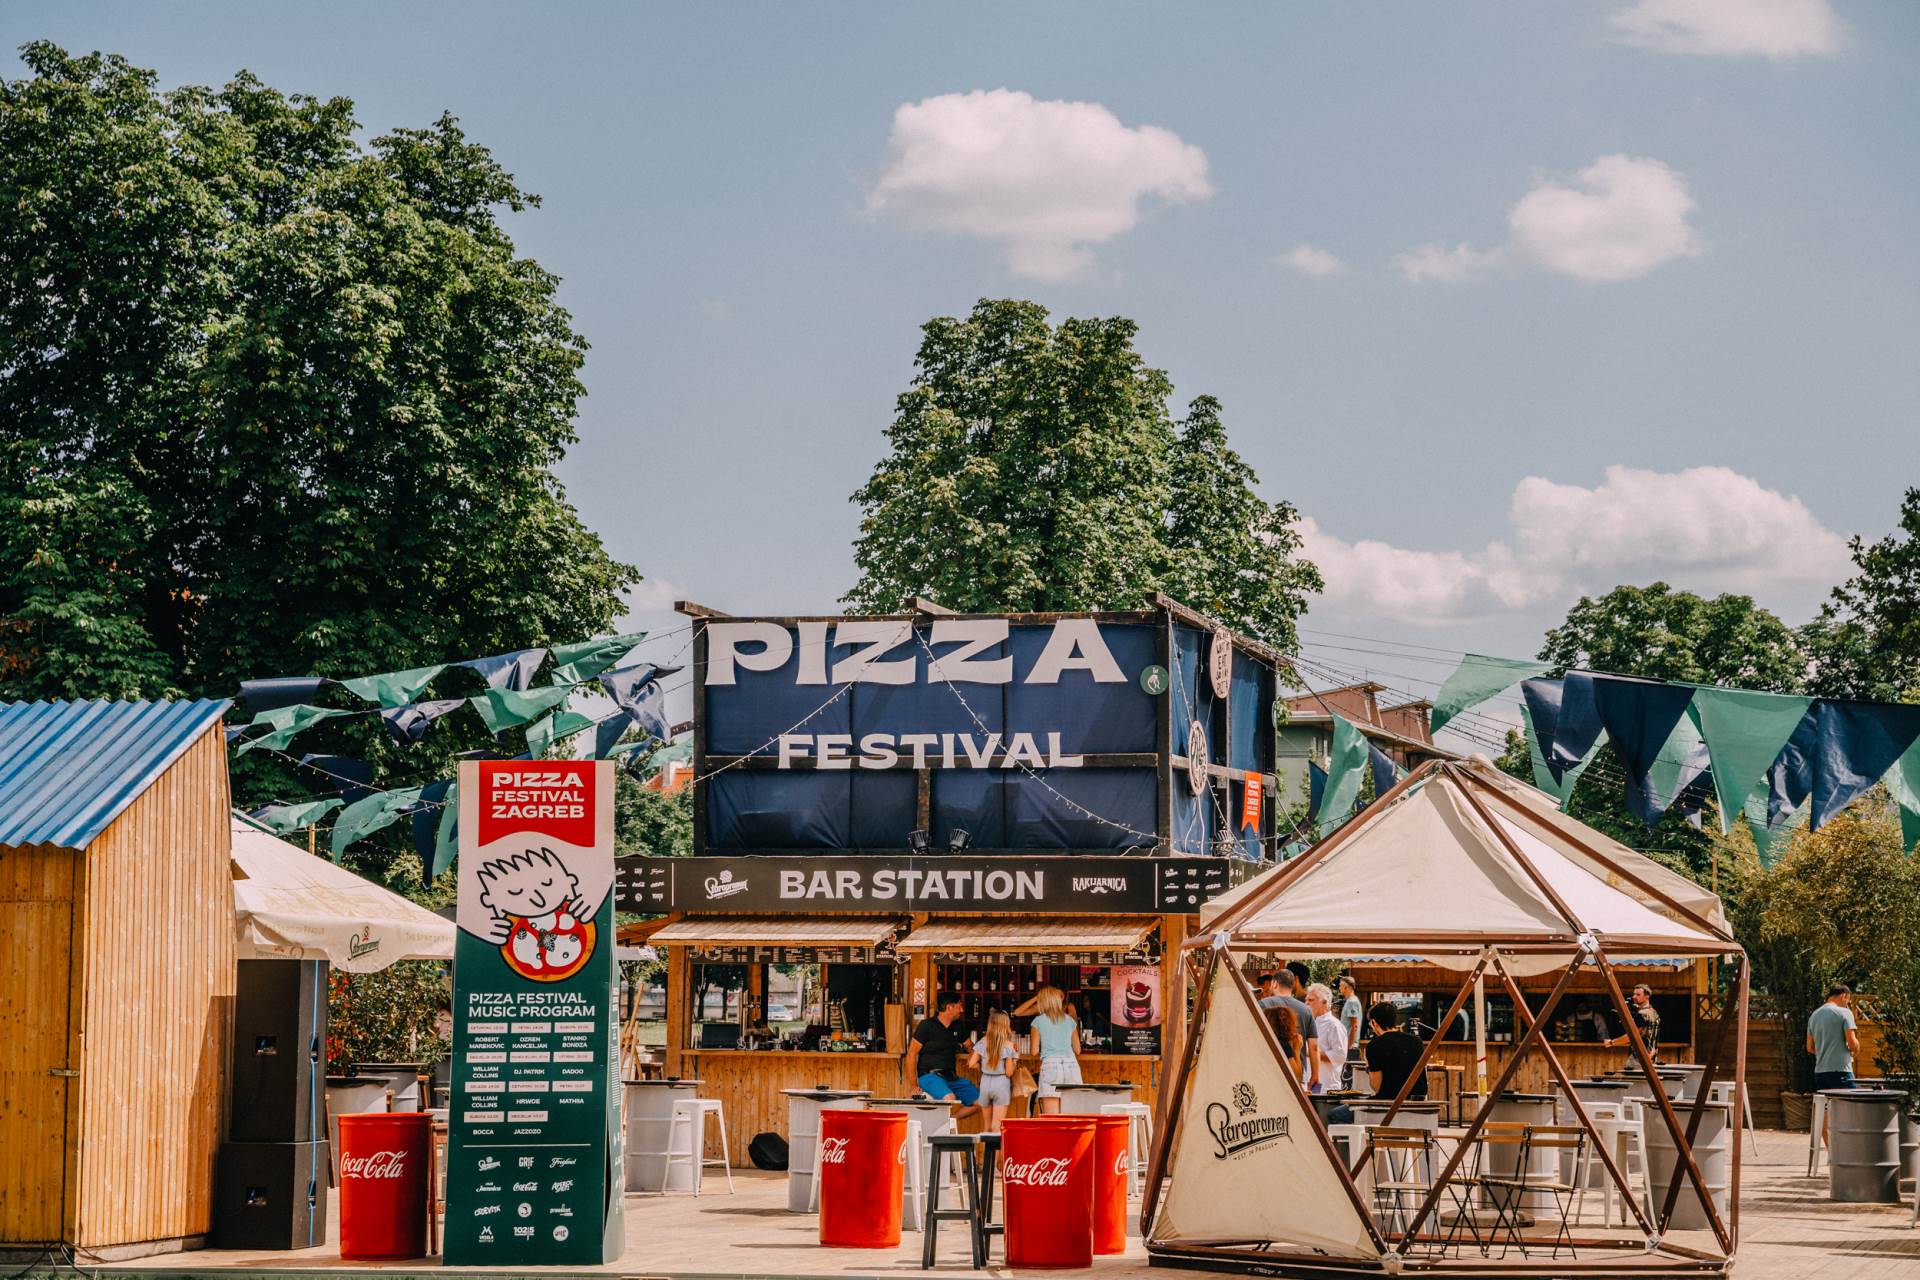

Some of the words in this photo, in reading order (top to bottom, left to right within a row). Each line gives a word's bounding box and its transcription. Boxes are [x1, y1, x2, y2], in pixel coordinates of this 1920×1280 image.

[705, 619, 1128, 686] PIZZA
[777, 732, 1084, 769] FESTIVAL
[492, 772, 584, 788] PIZZA
[492, 791, 585, 803] FESTIVAL
[491, 805, 585, 819] ZAGREB
[779, 870, 863, 900] BAR
[871, 870, 1045, 900] STATION
[468, 1006, 517, 1018] MUSIC
[520, 1006, 595, 1017] PROGRAM
[469, 993, 513, 1004] PIZZA
[517, 993, 587, 1004] FESTIVAL
[1206, 1102, 1293, 1160] Staropramen
[340, 1150, 408, 1179] Coca-Cola
[1003, 1156, 1073, 1186] Coca-Cola
